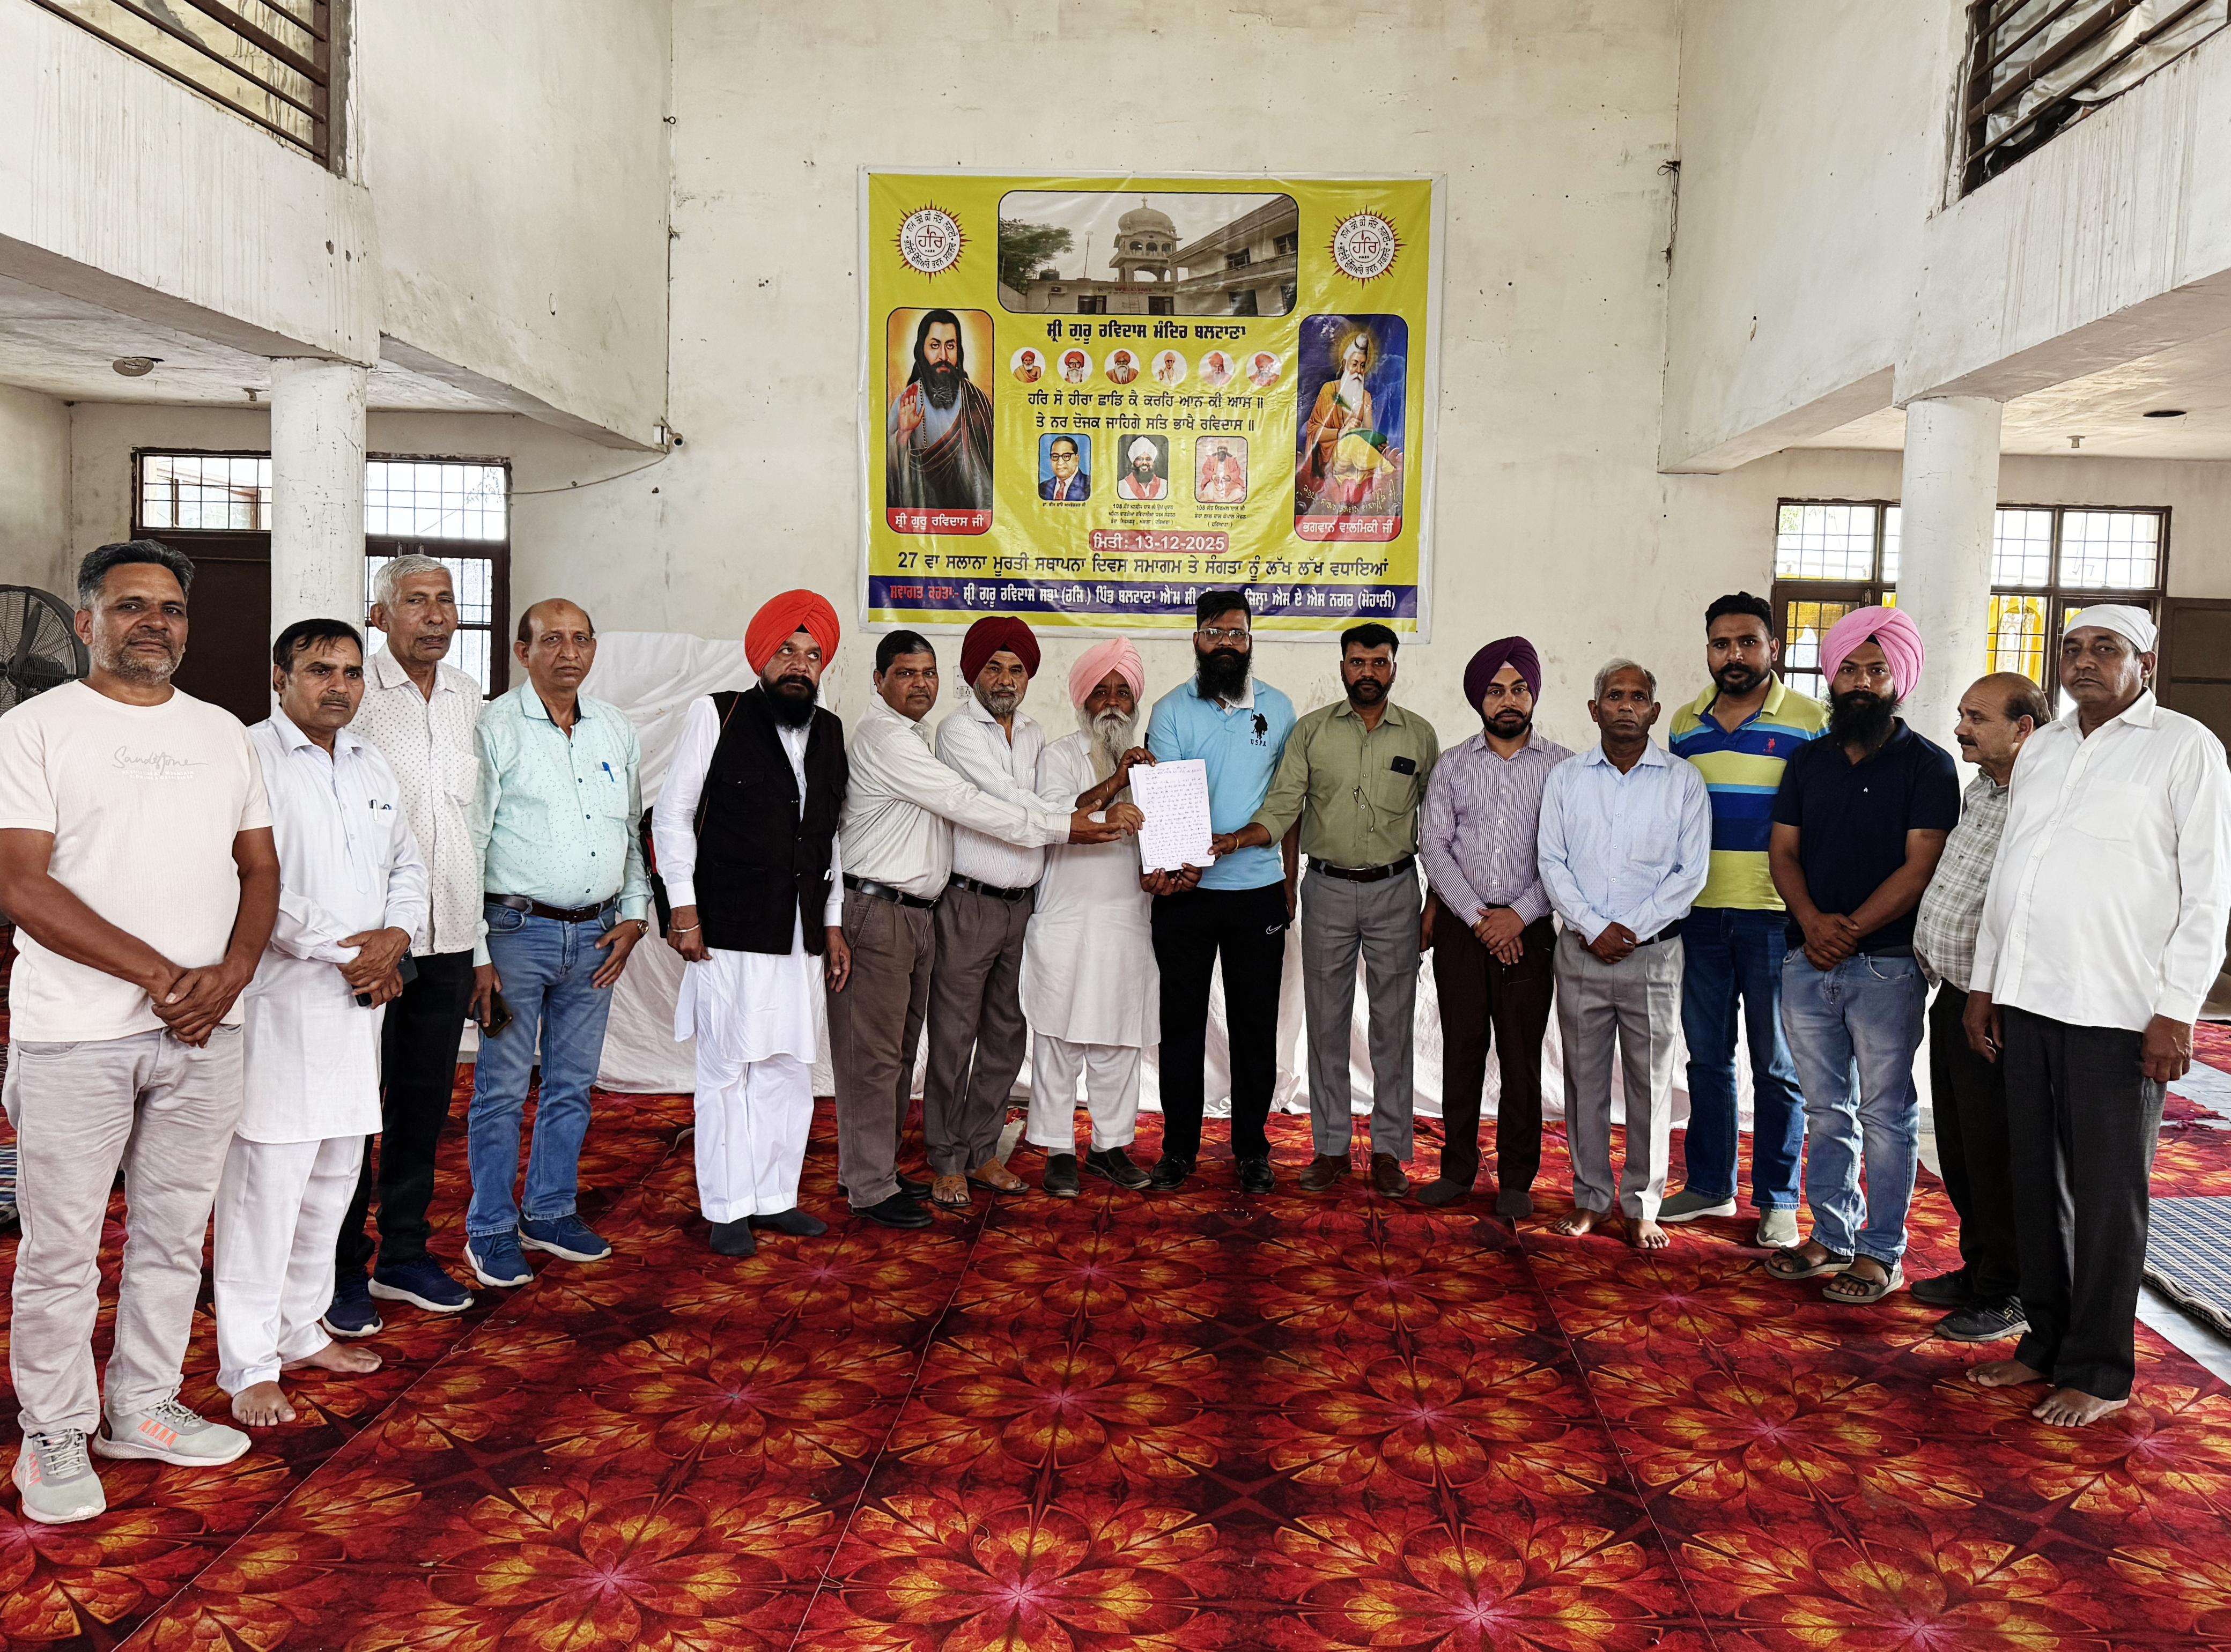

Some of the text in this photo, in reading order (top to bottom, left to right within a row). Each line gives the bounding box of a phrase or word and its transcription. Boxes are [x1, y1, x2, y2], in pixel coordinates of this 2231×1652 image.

[906, 221, 916, 232] ਨਾਮ
[925, 211, 931, 221] ਕੀ
[1341, 227, 1350, 239] ਨਾਮ
[1359, 216, 1365, 227] ਕੀ
[1069, 324, 1092, 344] ਗੁਰੂ
[1098, 320, 1147, 338] ਰਵਿਦਾਸ
[1153, 321, 1188, 338] ਮੰਦਿਰ
[1194, 325, 1246, 339] ਬਲਟਾਣਾ
[1028, 389, 1048, 405] ਹਰਿ
[1054, 388, 1063, 405] ਸੋ
[1068, 390, 1093, 405] ਹੀਰਾ
[1098, 390, 1124, 406] ਛਾਡਿ
[1129, 390, 1139, 406] ਕੈ
[1143, 391, 1174, 407] ਕਰਹਿ
[1179, 396, 1203, 408] ਆਨ
[1209, 392, 1222, 408] ਕੀ
[1228, 396, 1252, 409] ਆਸ
[1036, 412, 1045, 428] ਤੇ
[1050, 417, 1068, 428] ਨਰ
[1073, 412, 1100, 428] ਦੋਜਕ
[1106, 413, 1141, 429] ਜਾਹਿਗੇ
[1146, 413, 1168, 429] ਸਤਿ
[1173, 413, 1195, 430] ਭਾਖੈ
[1200, 414, 1243, 431] ਰਵਿਦਾਸ
[911, 516, 927, 530] ਗੁਰੂ
[932, 513, 968, 526] ਰਵਿਦਾਸ
[972, 514, 984, 527] ਜੀ
[1303, 519, 1393, 534] ਭਗਵਾਨ ਵਾਲਮਿਕੀ ਜੀ
[1135, 535, 1225, 550] 13-12-2025
[898, 552, 1388, 581] 27 ਵਾ ਸਲਾਨਾ ਮੂਰਤੀ ਸਥਾਪਨਾ ਦਿਵਸ ਸਮਾਗਮ ਤੇ ਸੰਗਤਾ ਨੂੰ ਲੱਖ ਲੱਖ ਵਧਾਇਆਂ
[890, 586, 924, 599] ਸਵਾਗਤ
[979, 587, 996, 608] ਗੁਰੂ
[1000, 583, 1035, 602] ਰਵਿਦਾਸ
[1039, 588, 1059, 602] ਸਭਾ
[1096, 586, 1114, 604] ਪਿੰਡ
[1118, 590, 1156, 604] ਬਲਟਾਣਾ
[1185, 587, 1196, 605] ਸੀ
[1272, 586, 1290, 606] ਐਸ
[1295, 588, 1302, 606] ਏ
[1307, 587, 1325, 607] ਐਸ
[1329, 594, 1354, 607] ਨਗਰ
[1358, 589, 1395, 610] (ਮੋਹਾਲੀ)
